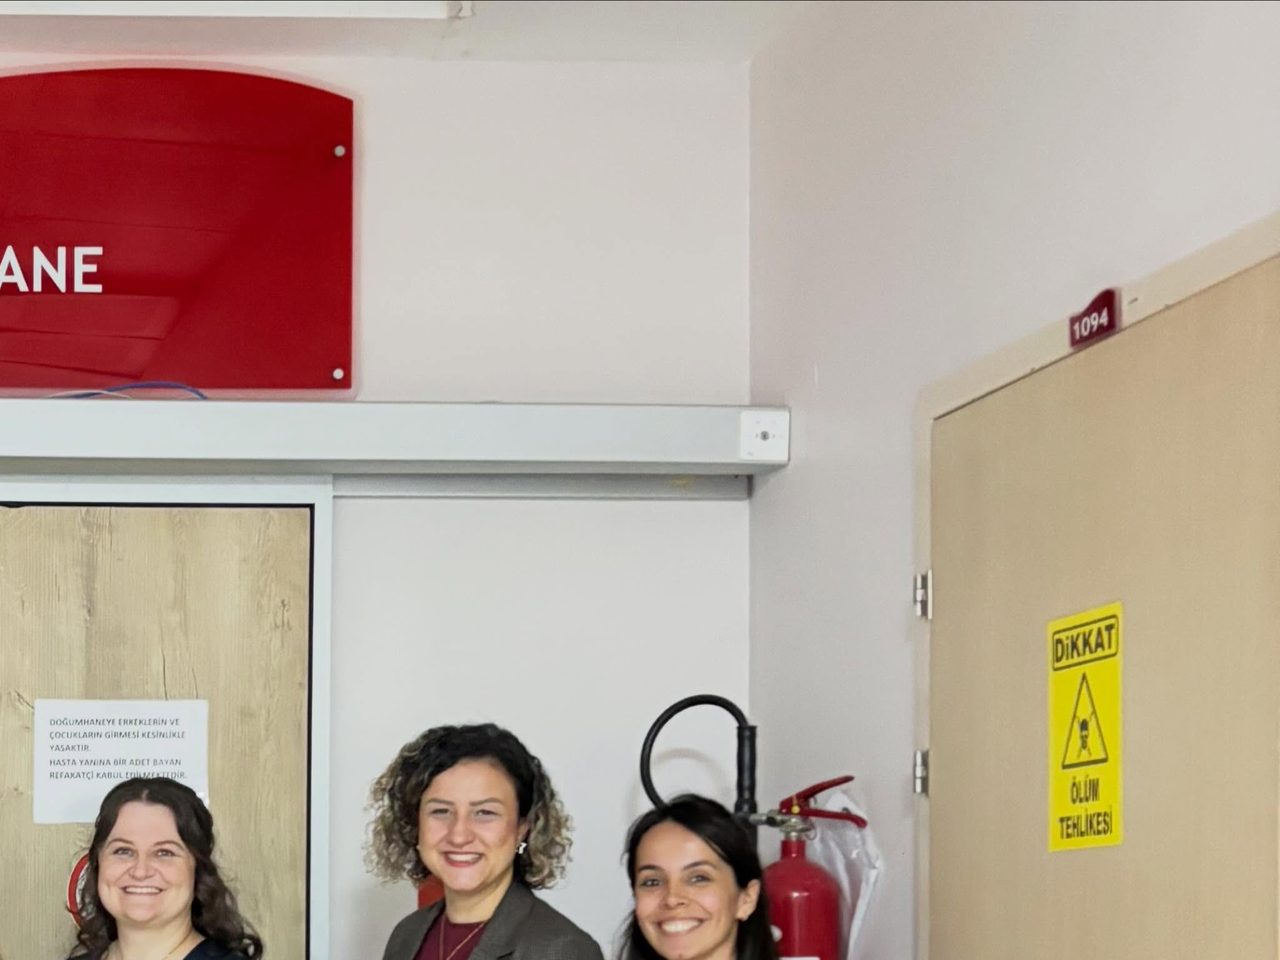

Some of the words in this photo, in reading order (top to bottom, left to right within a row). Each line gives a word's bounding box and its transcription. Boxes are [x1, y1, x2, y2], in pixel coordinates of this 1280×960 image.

[1072, 306, 1109, 341] 1094
[49, 717, 115, 726] DOĞUMHANEYE
[118, 717, 167, 726] ERKEKLERİN
[169, 718, 180, 726] VE
[49, 731, 102, 740] ÇOCUKLARIN
[104, 730, 139, 739] GİRMESİ
[141, 730, 185, 739] KESİNLİKLE
[113, 757, 126, 766] BİR
[49, 771, 94, 780] REFAKATÇİ
[96, 771, 123, 779] KABUL
[1071, 774, 1100, 805] ÖLÜM
[1058, 804, 1113, 840] TEHLİKESİ
